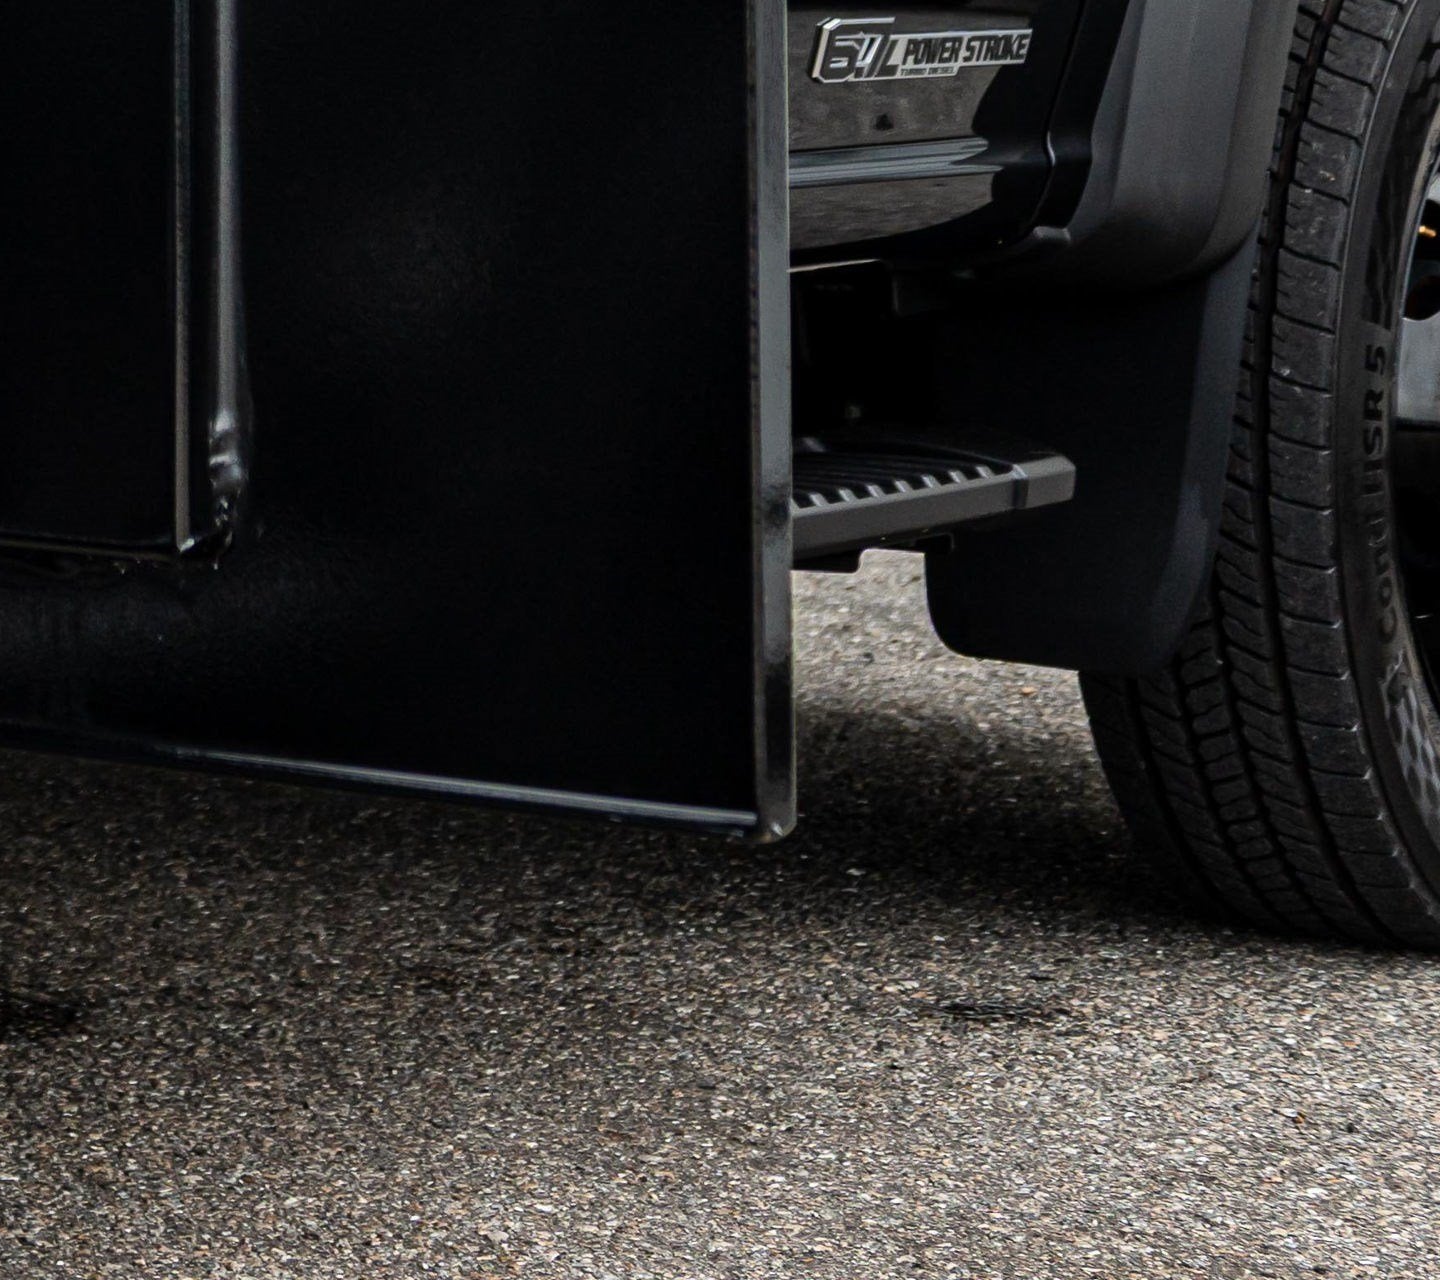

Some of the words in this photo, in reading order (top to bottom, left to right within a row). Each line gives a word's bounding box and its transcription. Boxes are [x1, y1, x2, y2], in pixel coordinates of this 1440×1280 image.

[901, 34, 961, 65] POWER
[962, 32, 1031, 63] STROKE
[1363, 345, 1388, 374] 5
